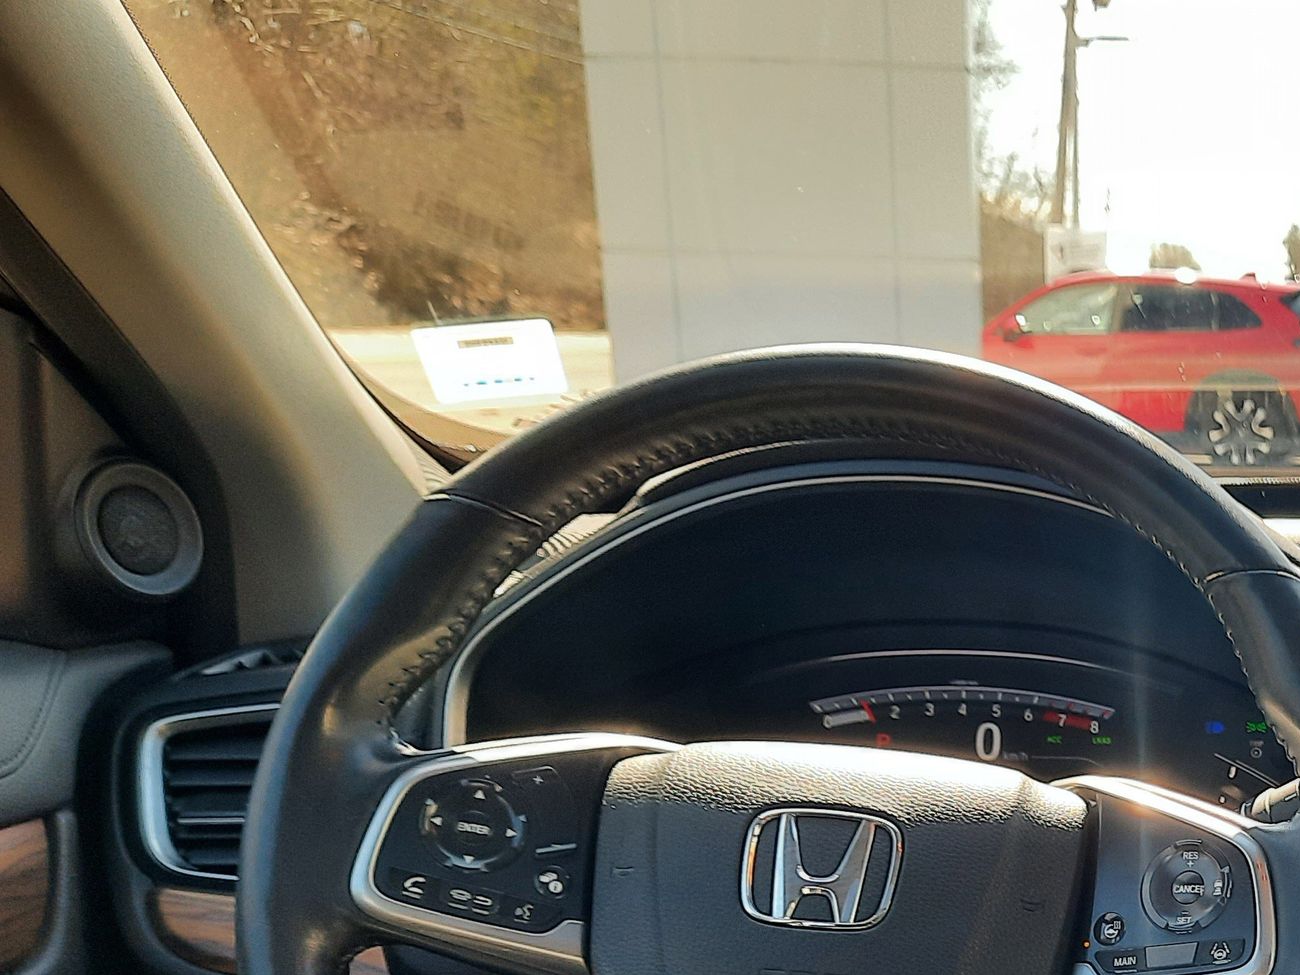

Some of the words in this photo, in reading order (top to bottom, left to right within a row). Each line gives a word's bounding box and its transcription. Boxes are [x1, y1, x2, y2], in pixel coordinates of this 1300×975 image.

[889, 705, 900, 719] 2
[925, 703, 935, 717] 3
[957, 703, 967, 715] 4
[991, 704, 1001, 717] 5
[1023, 708, 1033, 721] 6
[1058, 714, 1067, 727] 7
[1090, 721, 1099, 734] 8
[976, 722, 1001, 761] 0
[1182, 852, 1199, 860] RES
[1176, 916, 1192, 924] SET
[1113, 956, 1137, 967] MAIN
